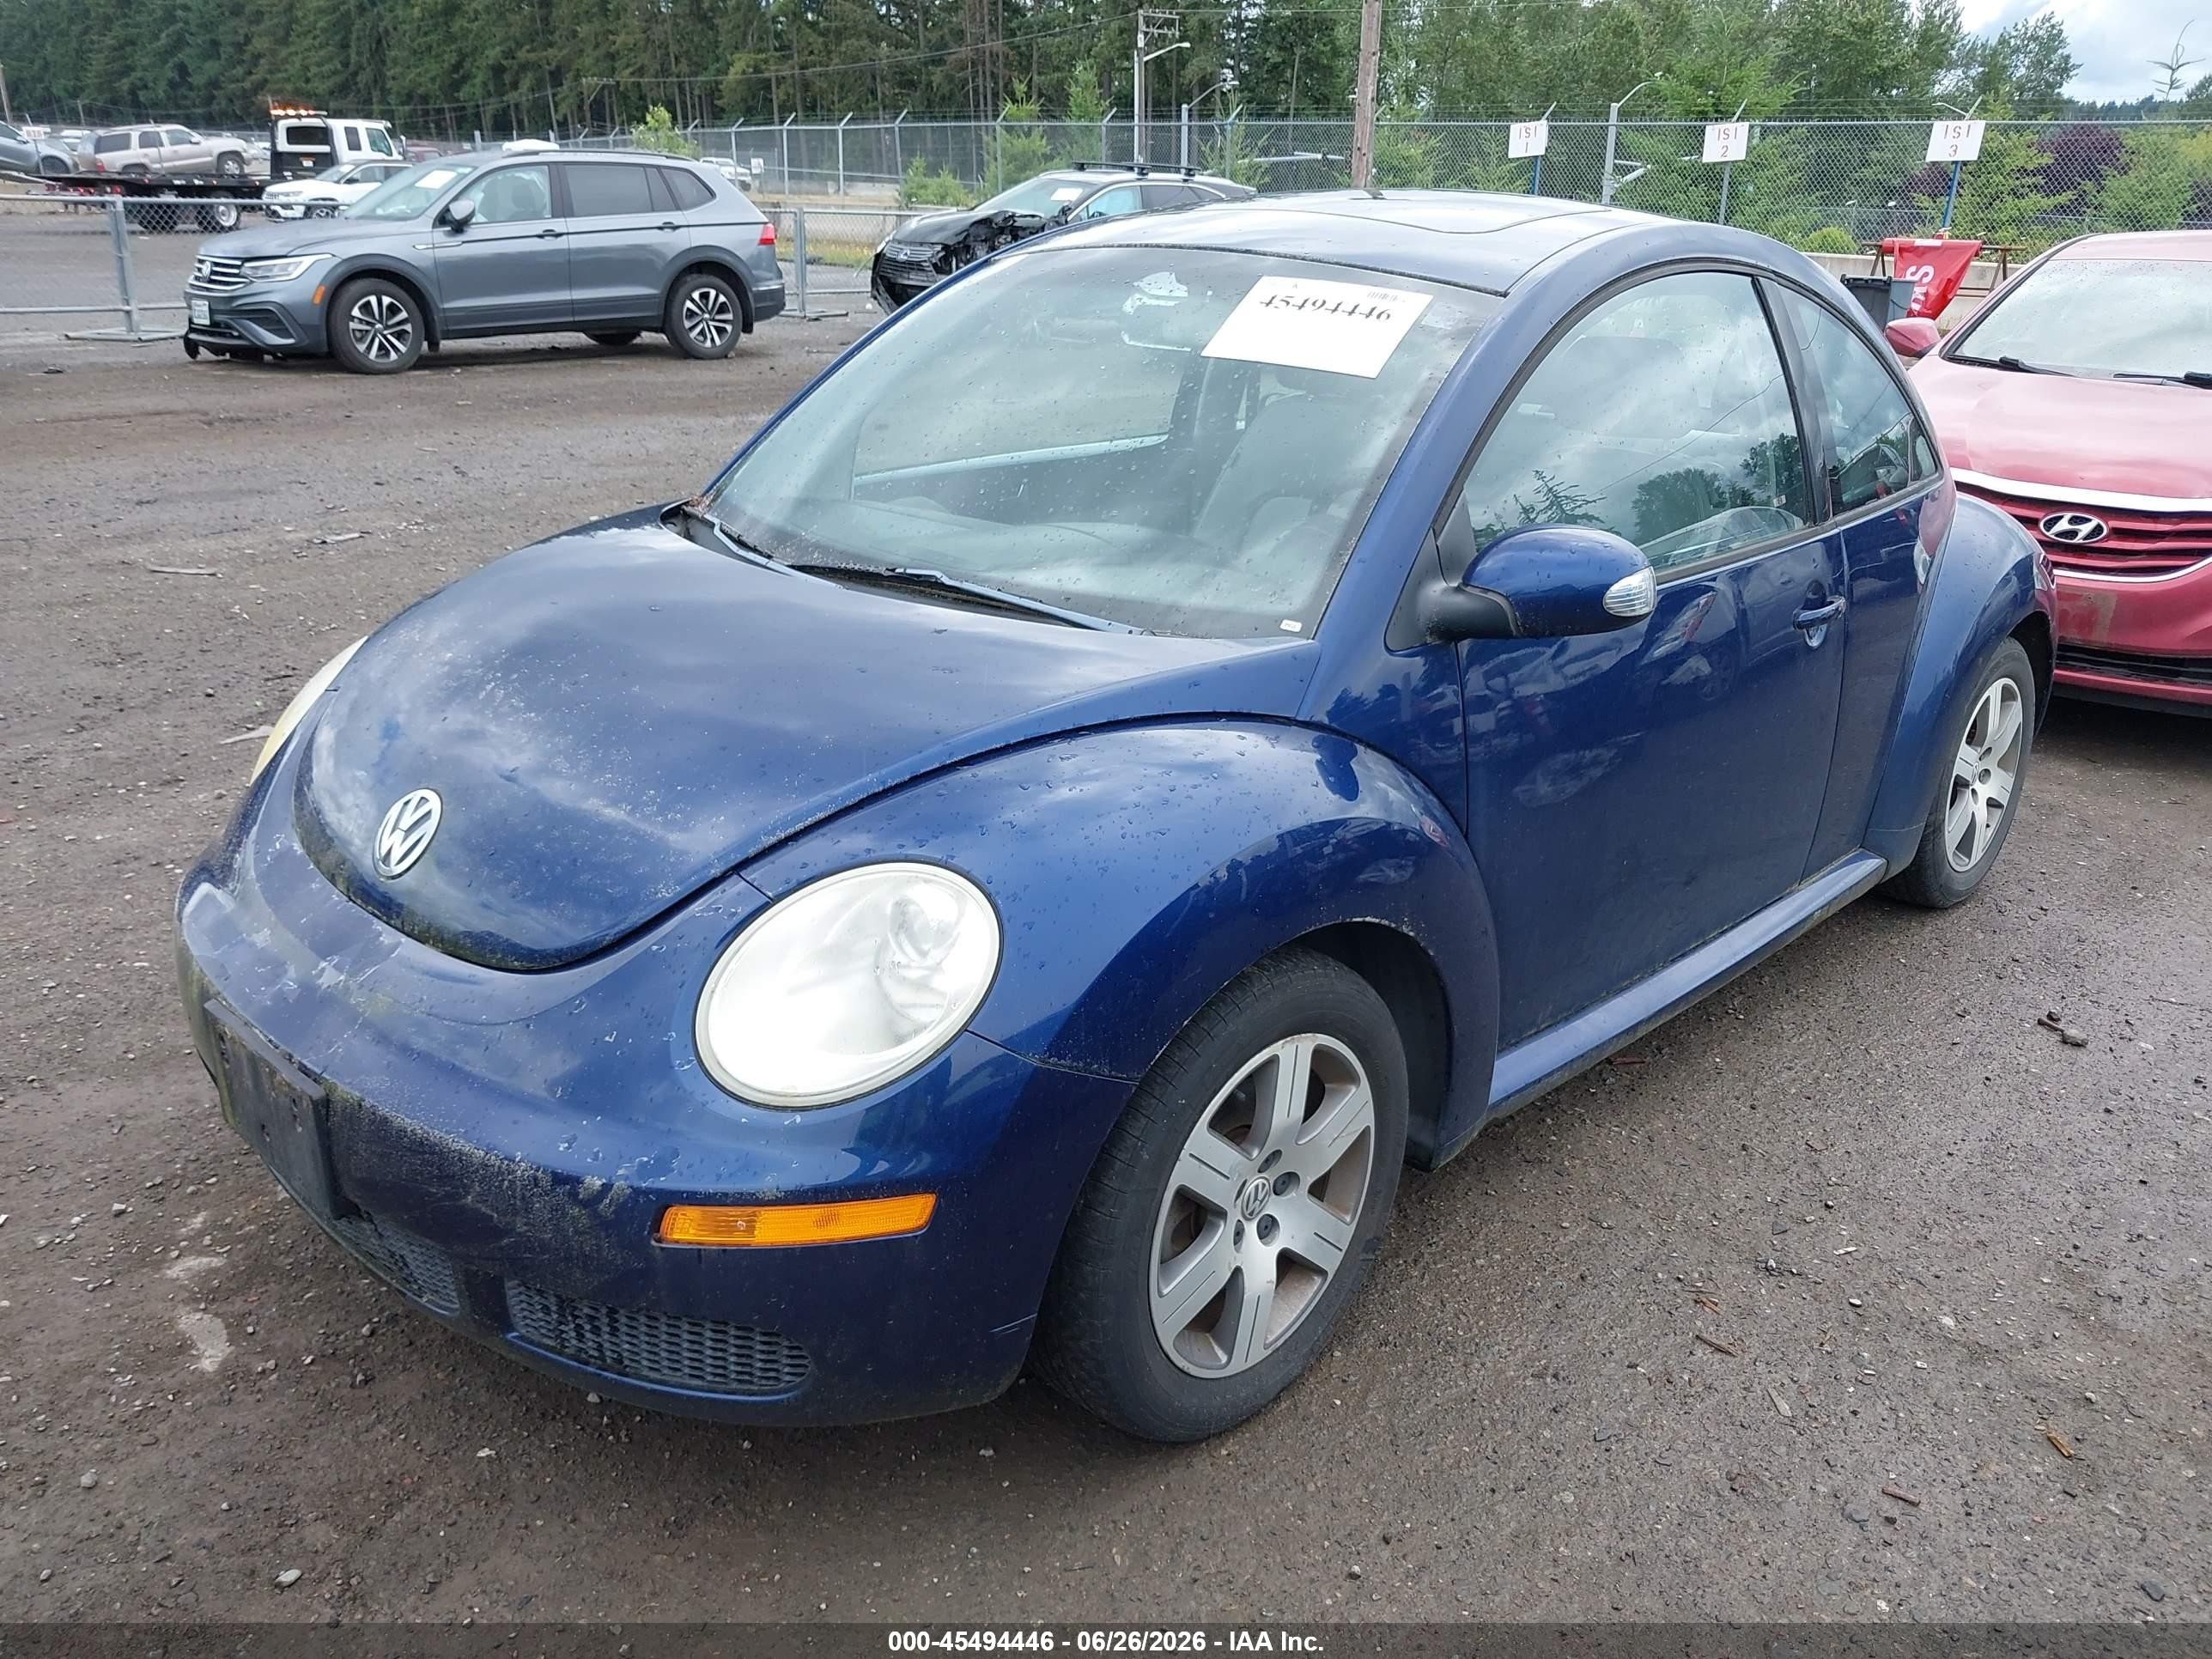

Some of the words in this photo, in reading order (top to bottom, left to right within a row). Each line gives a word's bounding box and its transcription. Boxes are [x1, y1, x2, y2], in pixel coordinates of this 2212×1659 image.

[1721, 144, 1729, 158] 2
[1948, 143, 1959, 158] 3
[1260, 294, 1392, 321] 45494446
[374, 789, 441, 878] VW
